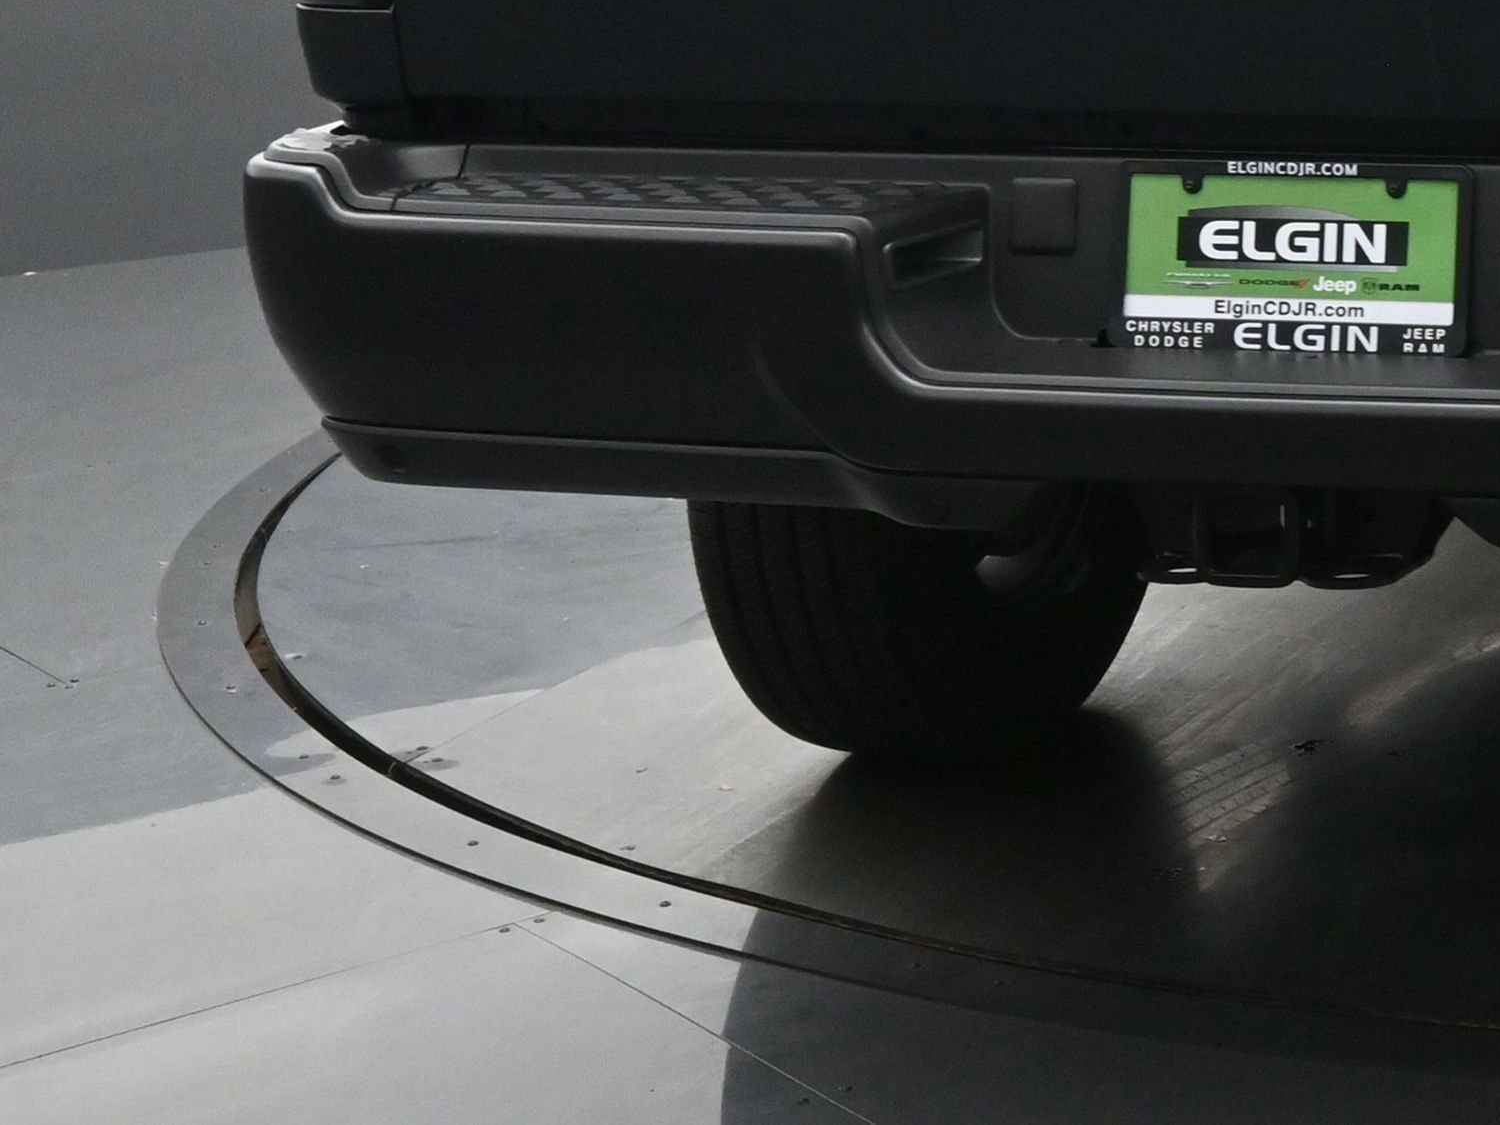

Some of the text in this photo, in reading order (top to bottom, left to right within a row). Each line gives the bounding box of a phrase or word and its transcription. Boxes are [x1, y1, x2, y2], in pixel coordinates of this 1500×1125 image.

[1227, 160, 1358, 176] ELGINCDJR.COM
[1198, 220, 1387, 264] ELGIN
[1239, 278, 1299, 286] DODGE
[1312, 275, 1358, 295] Jeep
[1377, 283, 1420, 292] RAM
[1214, 299, 1365, 318] ElginCDJR.com
[1125, 319, 1215, 335] CHRYSLER
[1402, 328, 1447, 341] JEEP
[1134, 334, 1204, 349] DODGE
[1233, 322, 1379, 353] ELGIN
[1402, 342, 1446, 354] RAM
